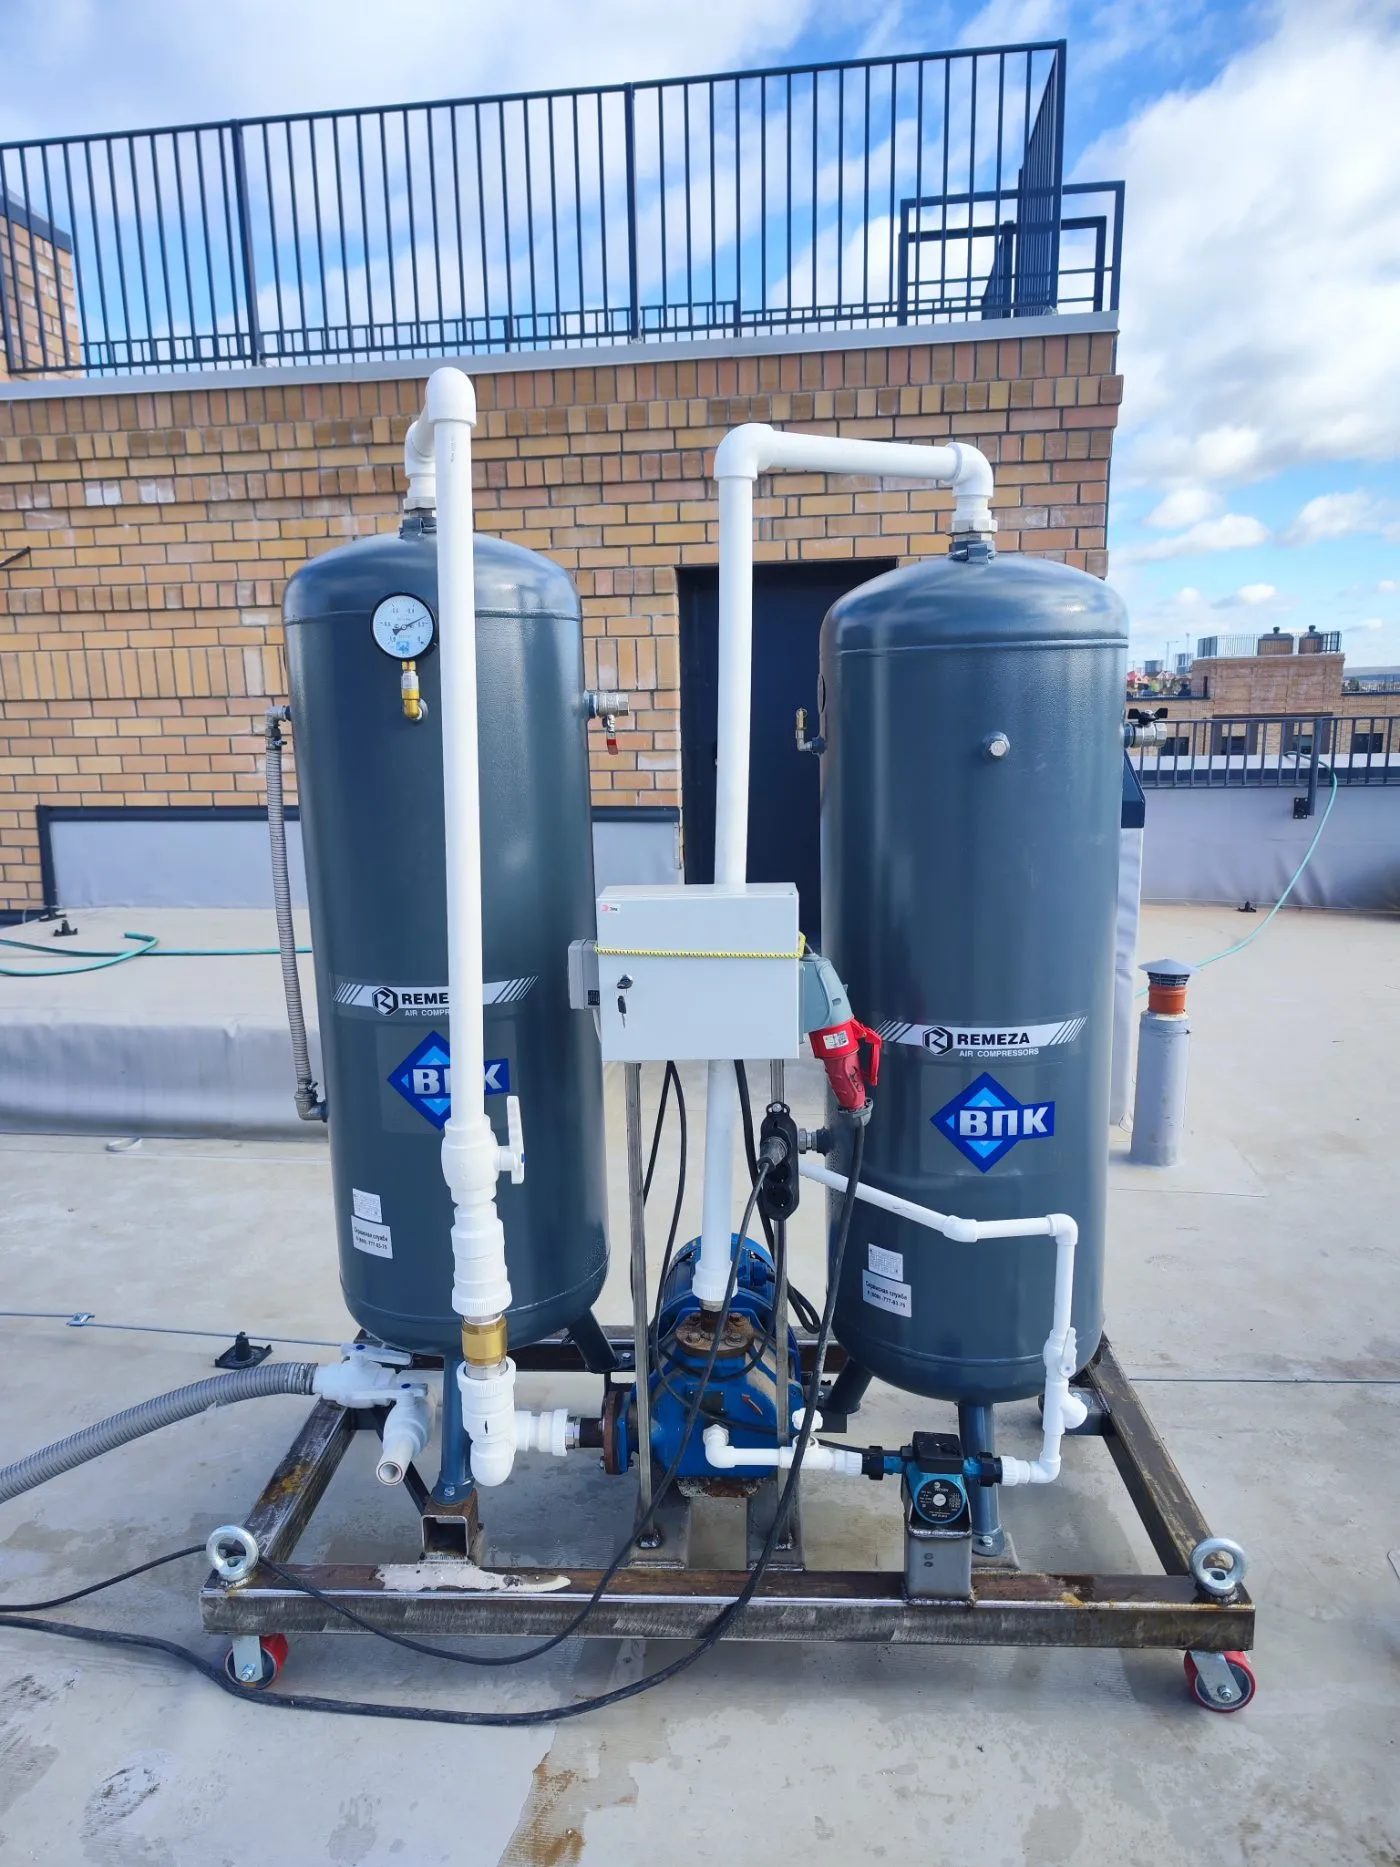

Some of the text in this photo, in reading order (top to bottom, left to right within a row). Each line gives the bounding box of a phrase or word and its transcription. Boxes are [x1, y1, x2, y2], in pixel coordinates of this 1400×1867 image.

[402, 993, 449, 1005] REME
[405, 1009, 418, 1017] AIR
[957, 1033, 1030, 1046] REMEZA
[977, 1047, 1040, 1058] COMPRESSORS
[959, 1107, 1048, 1137] ВПК
